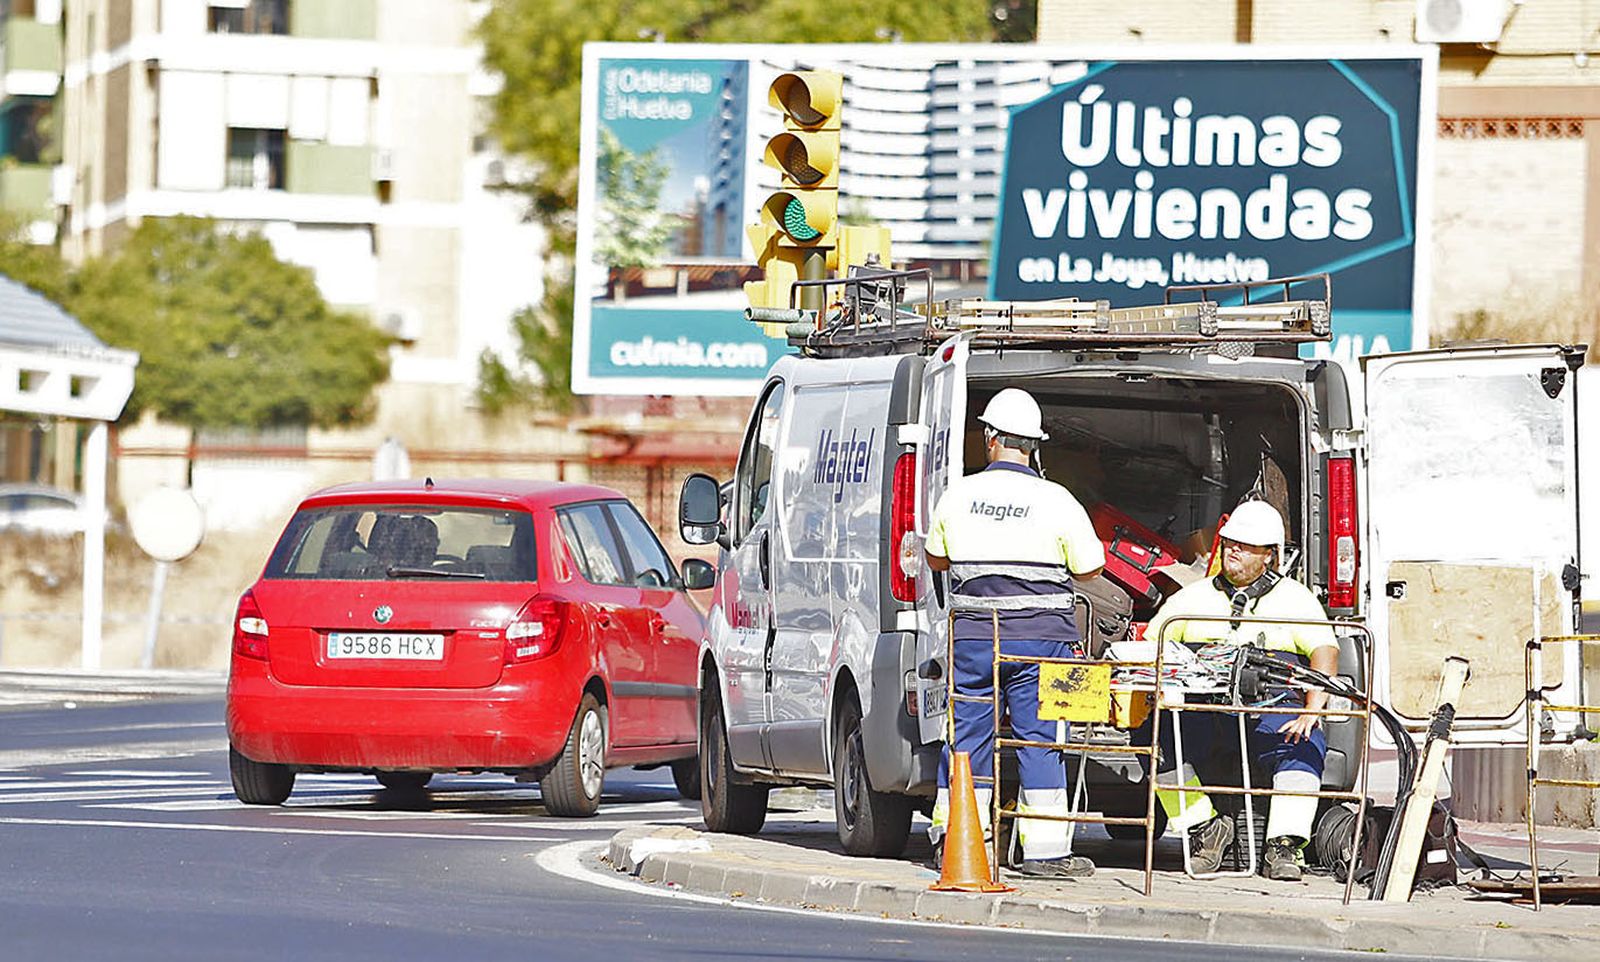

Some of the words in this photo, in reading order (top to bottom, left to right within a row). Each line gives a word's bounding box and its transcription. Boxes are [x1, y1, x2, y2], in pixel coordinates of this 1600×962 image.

[618, 95, 693, 120] Huelva
[1061, 84, 1343, 168] Últimas
[1022, 170, 1375, 241] viviendas
[1018, 257, 1056, 283] en
[1058, 252, 1093, 283] La
[1094, 252, 1170, 289] Joya,
[1172, 252, 1269, 283] Huelva
[610, 335, 768, 368] culmia.com
[813, 427, 876, 504] Magtel
[970, 500, 1030, 521] Magtel
[342, 636, 392, 655] 9586
[398, 637, 435, 656] HCX
